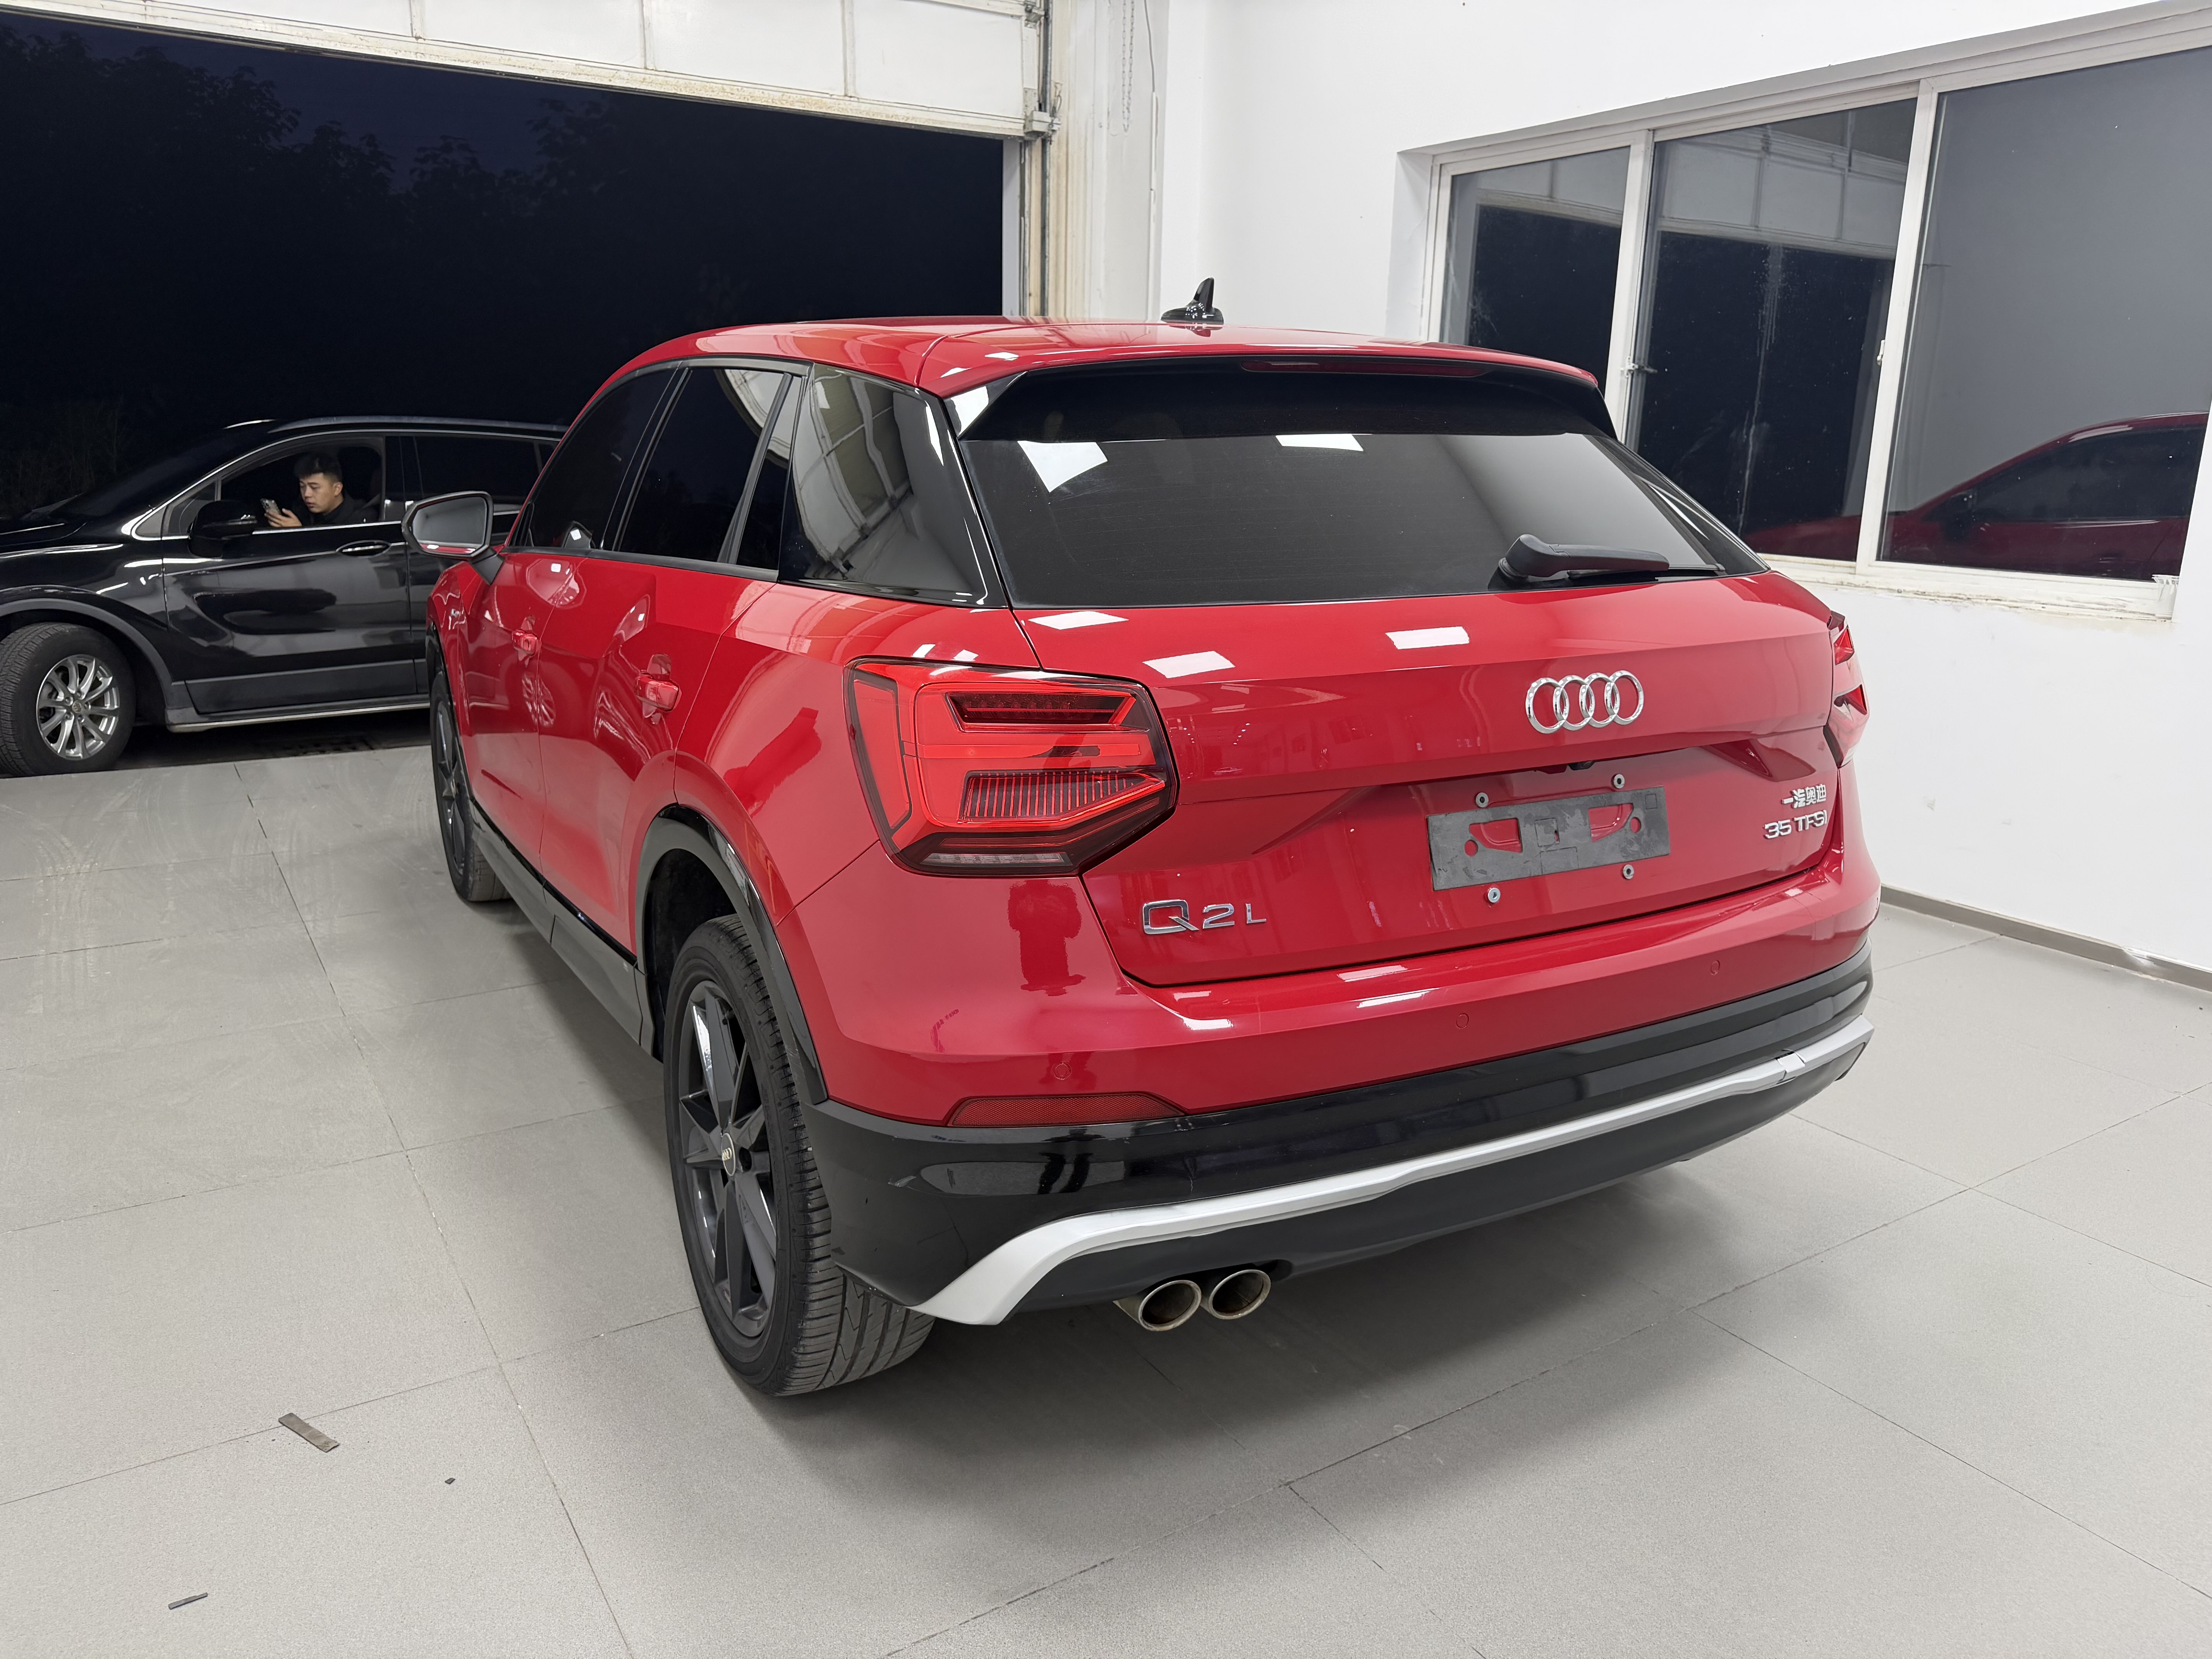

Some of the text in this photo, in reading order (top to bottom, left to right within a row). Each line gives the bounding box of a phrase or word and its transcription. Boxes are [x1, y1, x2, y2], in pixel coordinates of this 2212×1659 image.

[1782, 784, 1826, 808] 一汽奥迪
[1764, 809, 1827, 838] 35 TFSI
